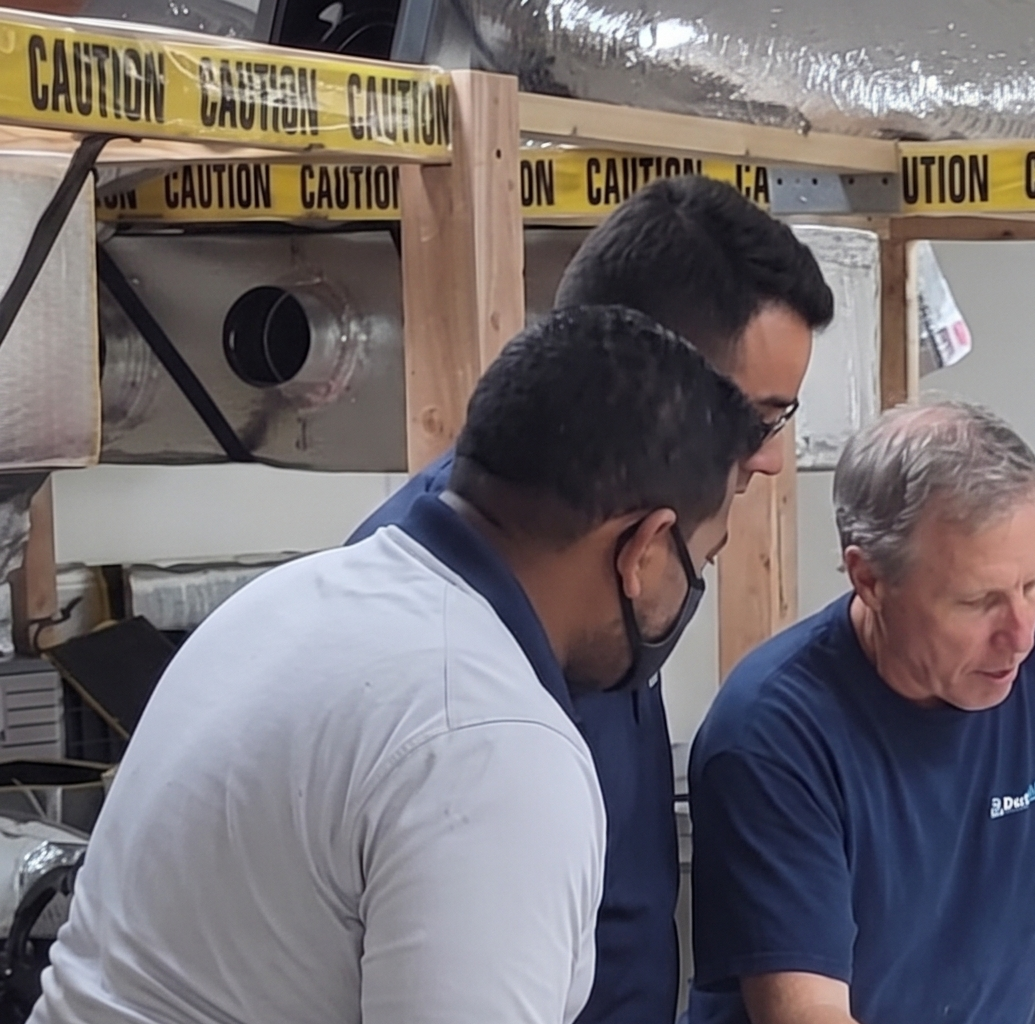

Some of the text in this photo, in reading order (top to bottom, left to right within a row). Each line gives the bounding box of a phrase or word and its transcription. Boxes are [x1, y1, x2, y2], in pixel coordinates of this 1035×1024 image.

[28, 34, 451, 146] CAUTION CAUTION CAUTION
[164, 163, 271, 209] CAUTION
[902, 154, 989, 205] UTION
